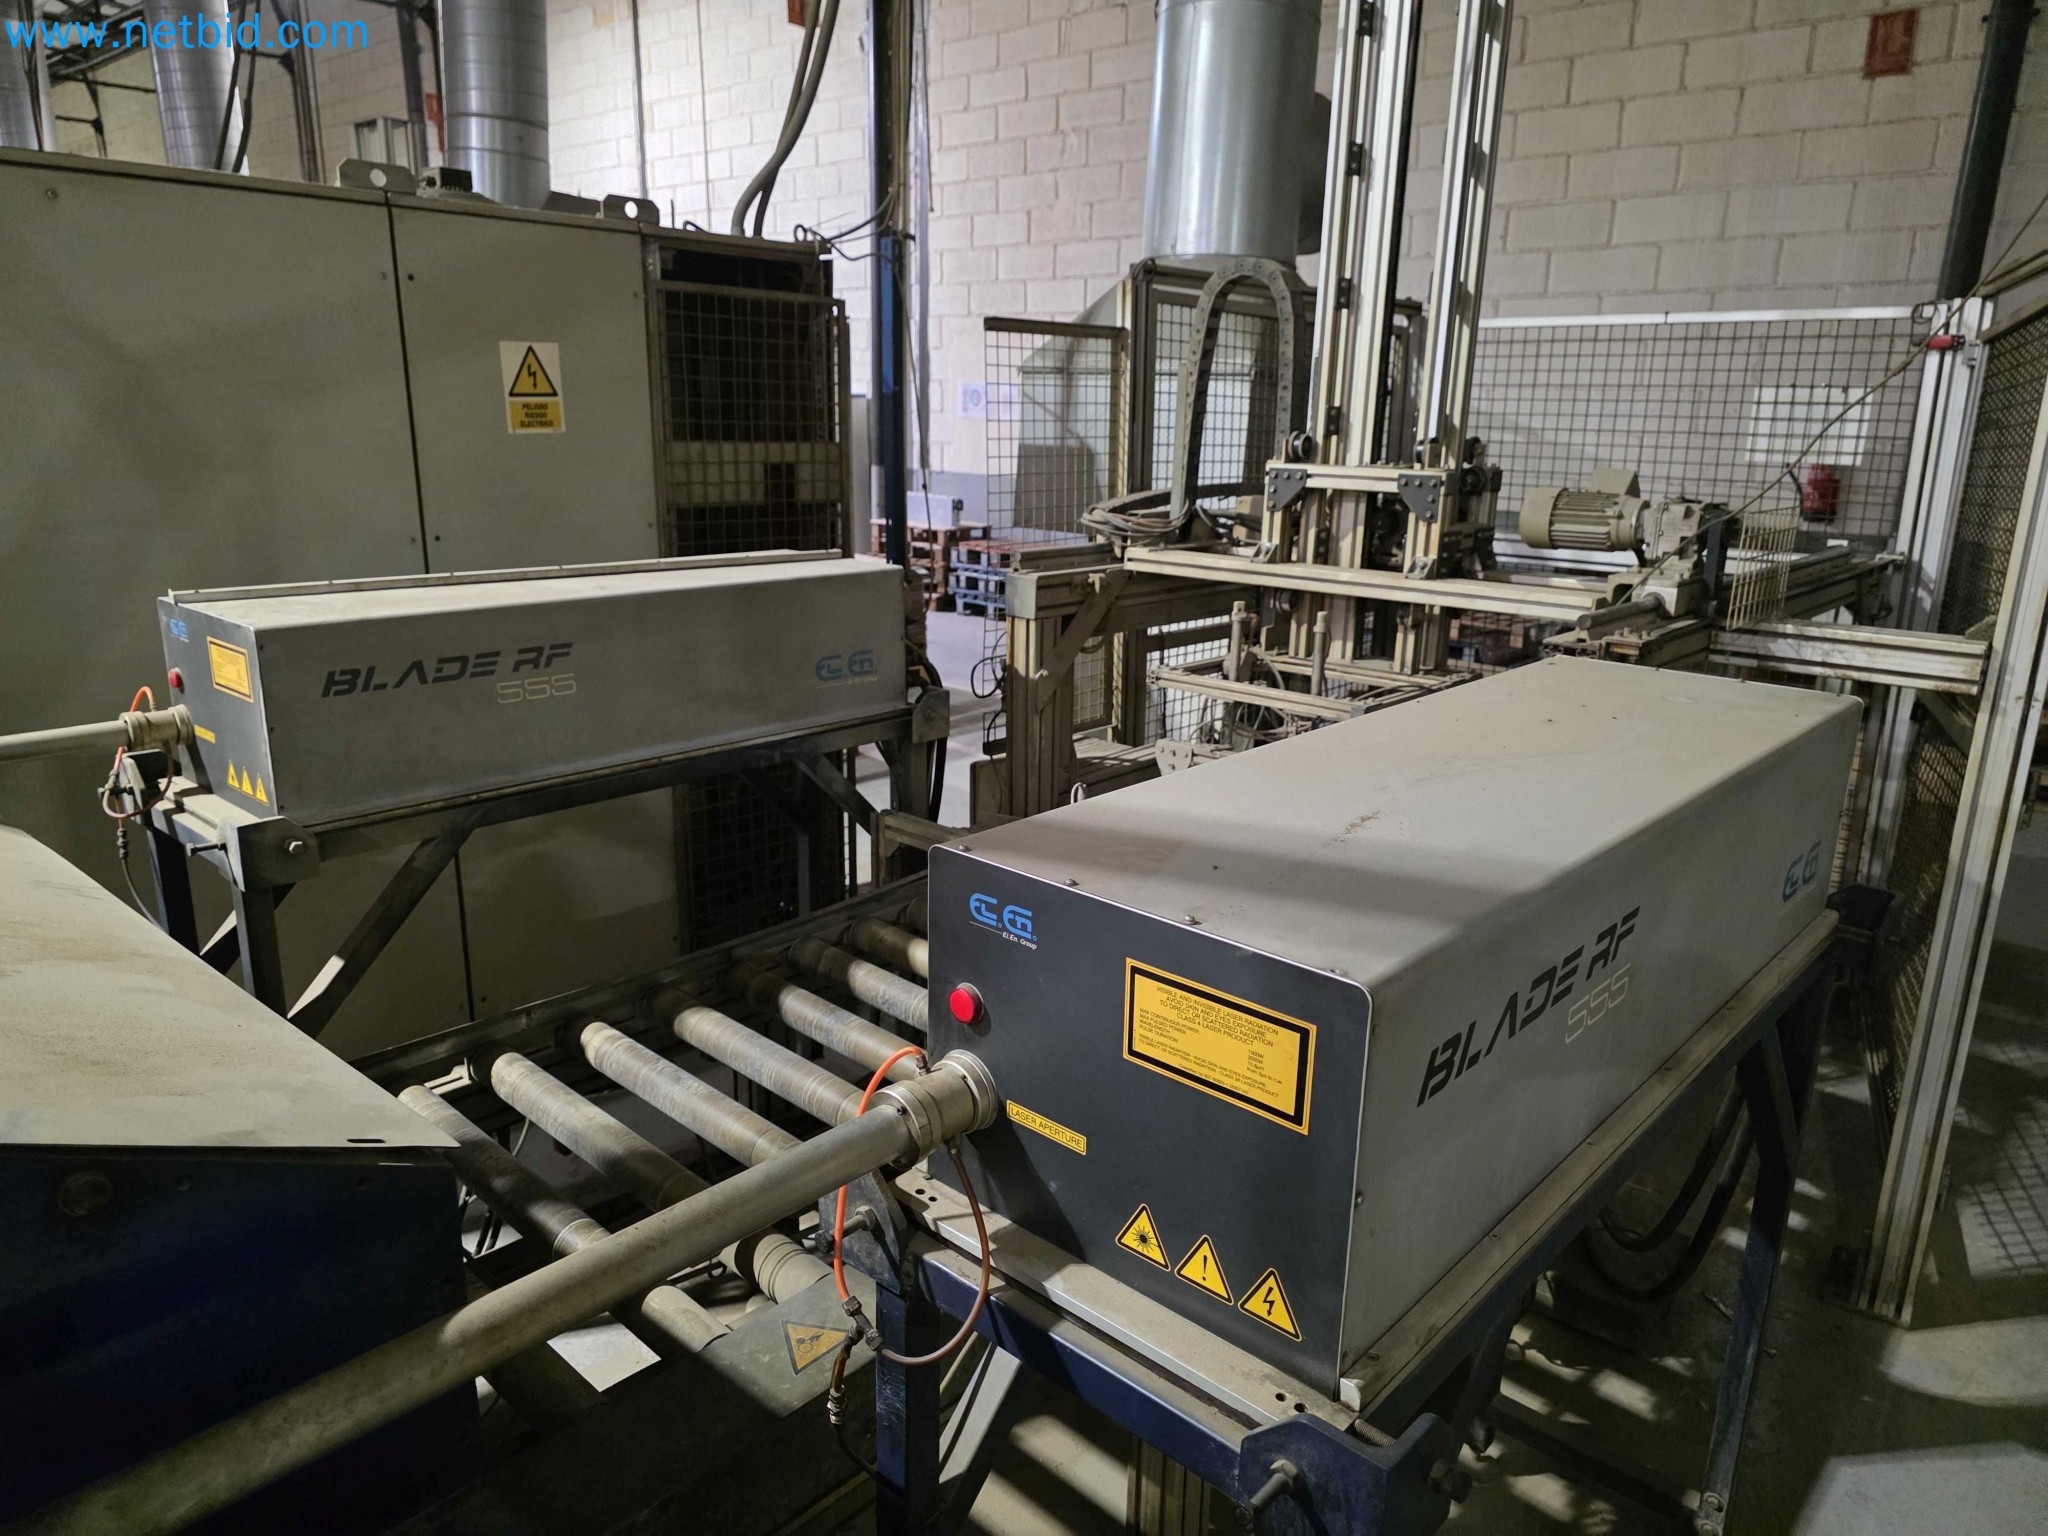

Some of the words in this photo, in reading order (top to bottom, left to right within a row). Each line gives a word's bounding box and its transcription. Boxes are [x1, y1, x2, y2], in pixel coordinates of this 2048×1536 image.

[321, 651, 501, 698] BLADE
[512, 642, 573, 672] RF
[1019, 939, 1037, 950] Group
[1140, 1007, 1149, 1015] MAX
[1151, 1012, 1181, 1027] CONTINUOUS
[1157, 986, 1178, 998] VISIBLE
[1179, 994, 1192, 1003] AND
[1193, 999, 1222, 1014] INVISIBLE
[1223, 1010, 1243, 1022] LASER
[1245, 1018, 1278, 1035] RADIATION
[1167, 996, 1183, 1006] AVOID
[1185, 1002, 1199, 1012] SKIN
[1200, 1008, 1214, 1018] AND
[1215, 1014, 1231, 1024] EYES
[1233, 1020, 1266, 1037] EXPOSURE
[1169, 1003, 1190, 1015] DIRECT
[1192, 1011, 1200, 1019] OR
[1202, 1015, 1238, 1034] SCATTERED
[1240, 1029, 1273, 1047] RADIATION
[1417, 945, 1585, 1108] BLADE
[1585, 905, 1641, 982] RF
[1177, 1013, 1196, 1024] CLASS
[1203, 1022, 1222, 1034] LASER
[1223, 1030, 1254, 1046] PRODUCT
[1011, 1106, 1037, 1127] LASER
[1038, 1122, 1083, 1149] APERTURE
